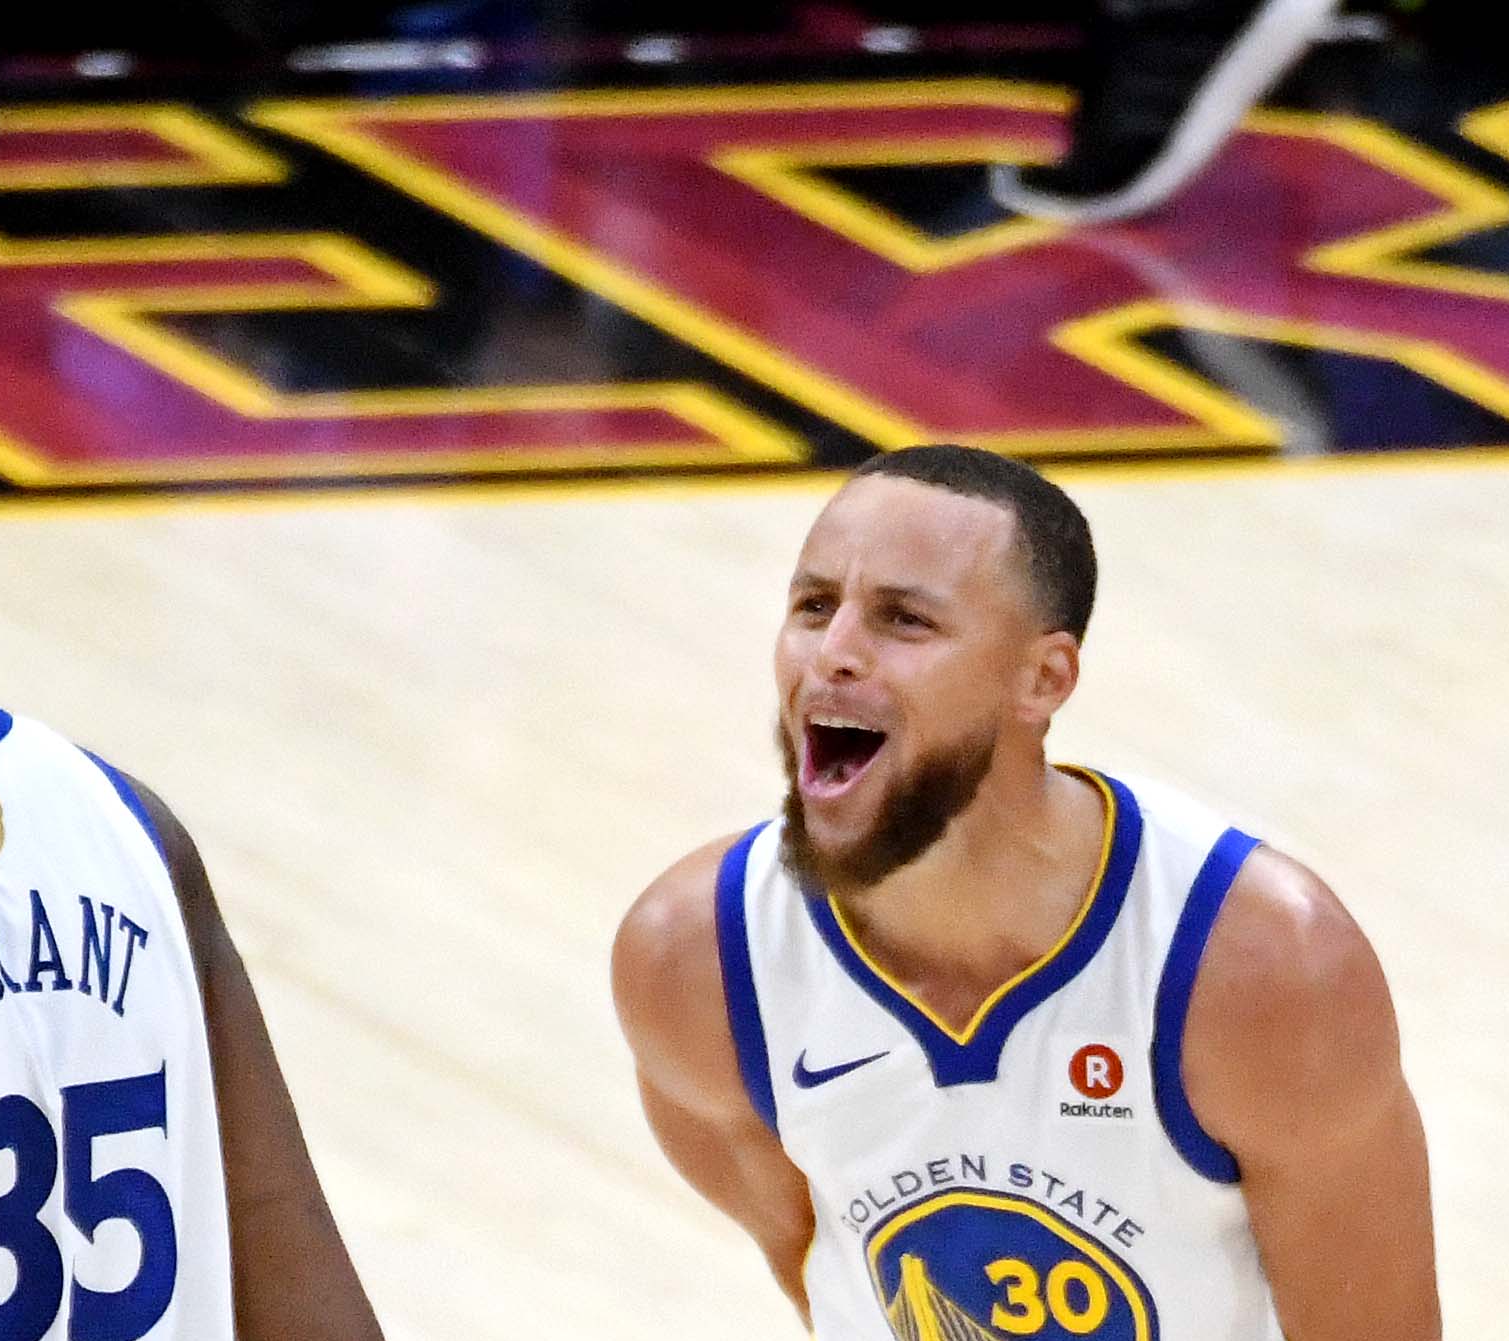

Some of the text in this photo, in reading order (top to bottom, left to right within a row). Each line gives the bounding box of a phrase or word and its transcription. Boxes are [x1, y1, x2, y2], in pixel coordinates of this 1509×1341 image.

[1085, 1055, 1112, 1089] R
[1060, 1102, 1133, 1119] Rakuten
[1007, 1163, 1145, 1249] STATE
[987, 1258, 1109, 1335] 30
